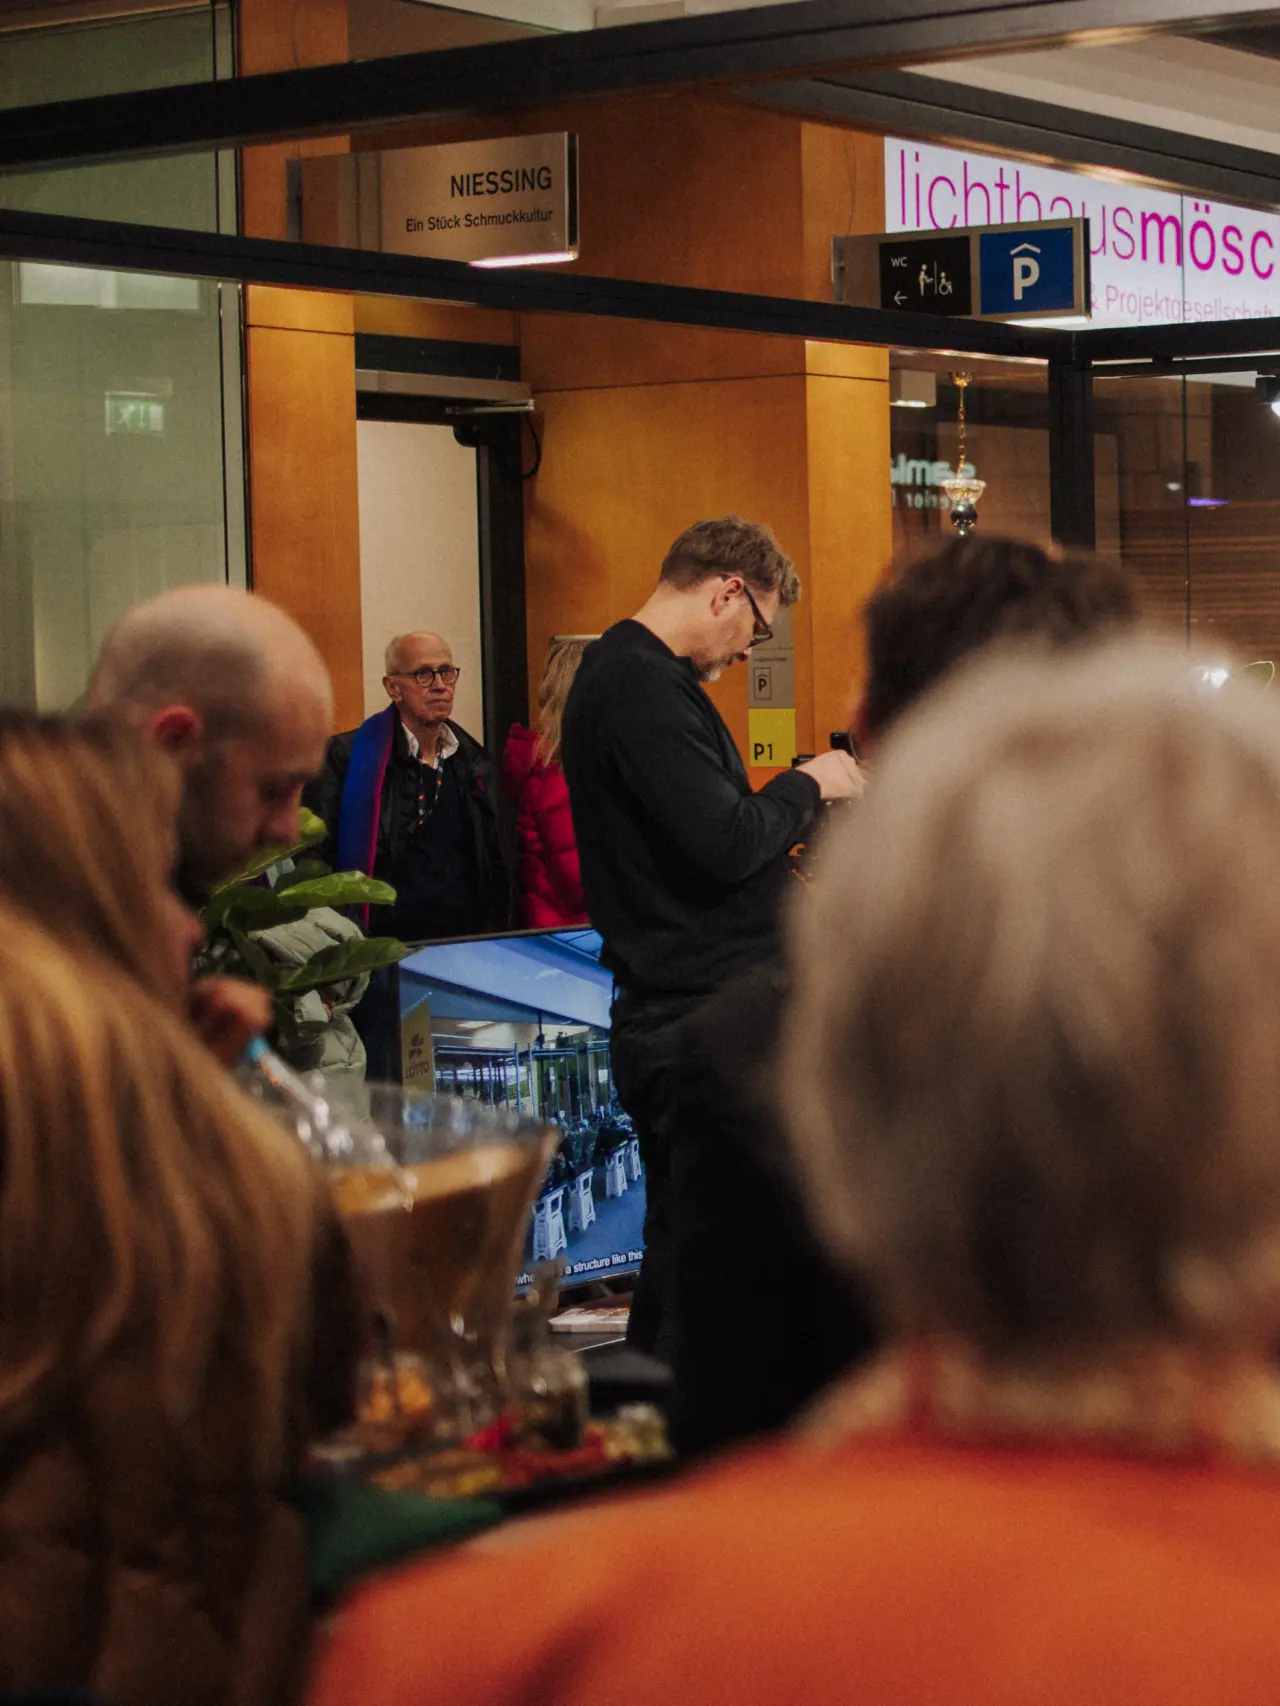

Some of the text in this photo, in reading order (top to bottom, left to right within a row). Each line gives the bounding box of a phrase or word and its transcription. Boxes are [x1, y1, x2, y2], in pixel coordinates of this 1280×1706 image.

[451, 166, 552, 198] NIESSING
[406, 207, 553, 232] Ein Stück Schmuckkultur
[891, 256, 908, 268] WC
[1013, 257, 1040, 300] P
[754, 743, 773, 760] P1
[565, 1265, 572, 1274] a
[573, 1257, 610, 1273] structure
[612, 1253, 626, 1265] like
[628, 1249, 644, 1261] this
